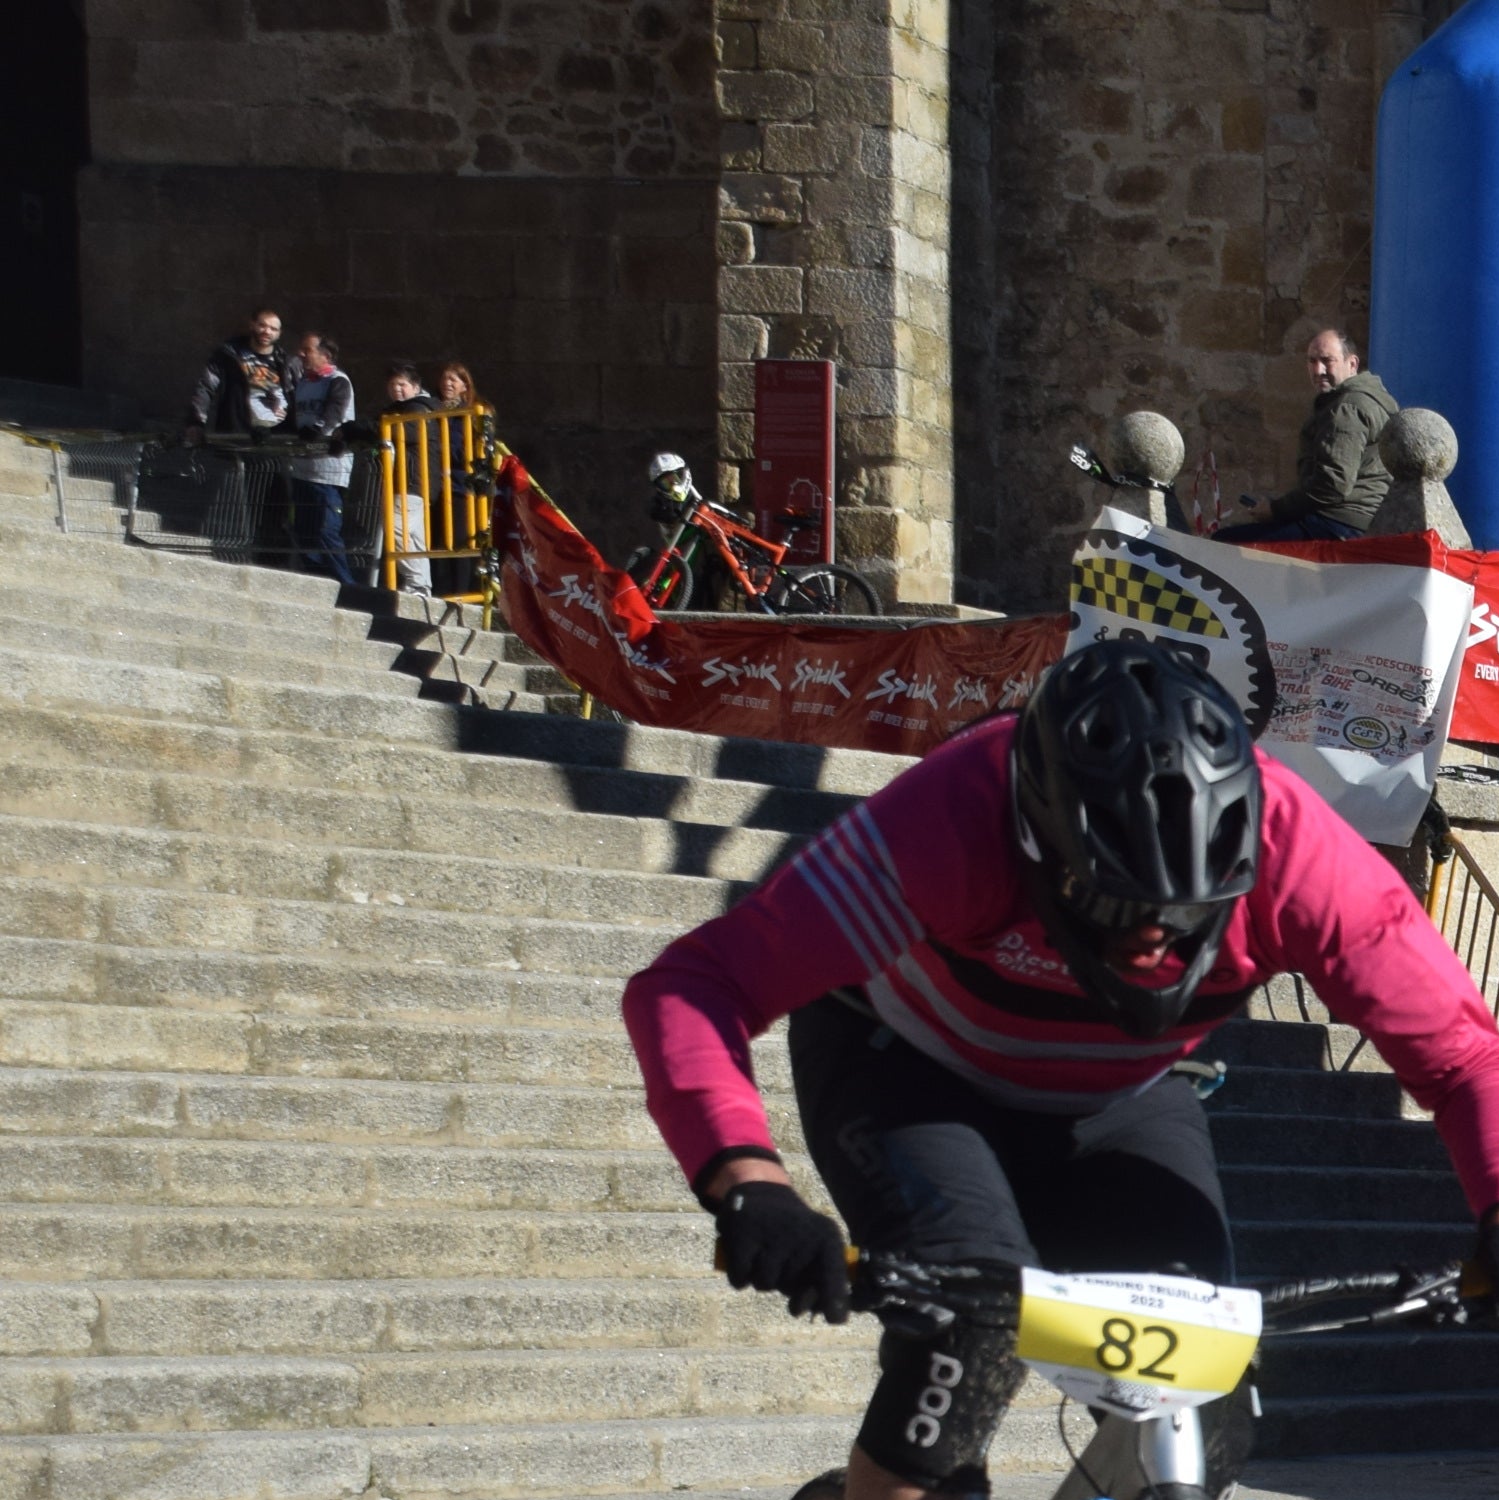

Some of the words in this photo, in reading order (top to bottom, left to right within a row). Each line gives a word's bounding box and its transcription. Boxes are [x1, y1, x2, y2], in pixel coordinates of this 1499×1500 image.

[1321, 674, 1355, 692] BIKE
[1475, 664, 1499, 681] EVERY
[1352, 669, 1427, 708] ORBEA
[1096, 1318, 1179, 1382] 82
